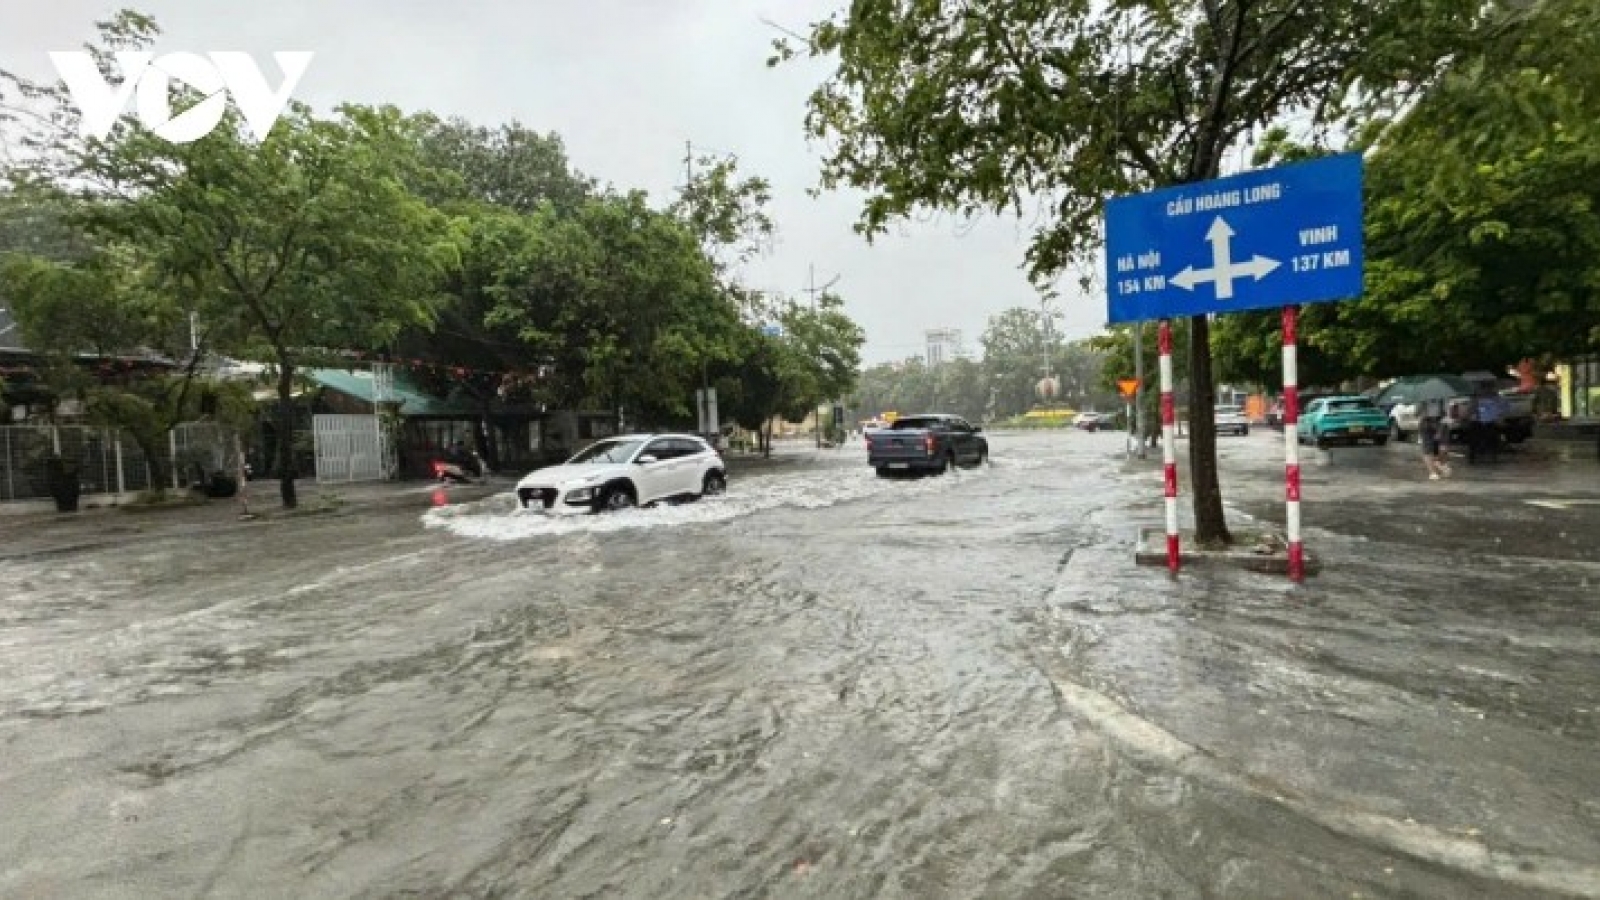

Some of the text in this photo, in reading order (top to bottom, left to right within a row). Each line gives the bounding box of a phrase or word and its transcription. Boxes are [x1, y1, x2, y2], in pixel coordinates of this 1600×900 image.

[1195, 190, 1240, 211] HOÀNG
[1243, 183, 1281, 205] LONG
[1299, 224, 1338, 246] VINH
[1117, 249, 1162, 272] HÀ NỘI
[1291, 248, 1350, 273] 137 KM
[1117, 275, 1166, 295] 154 KM
